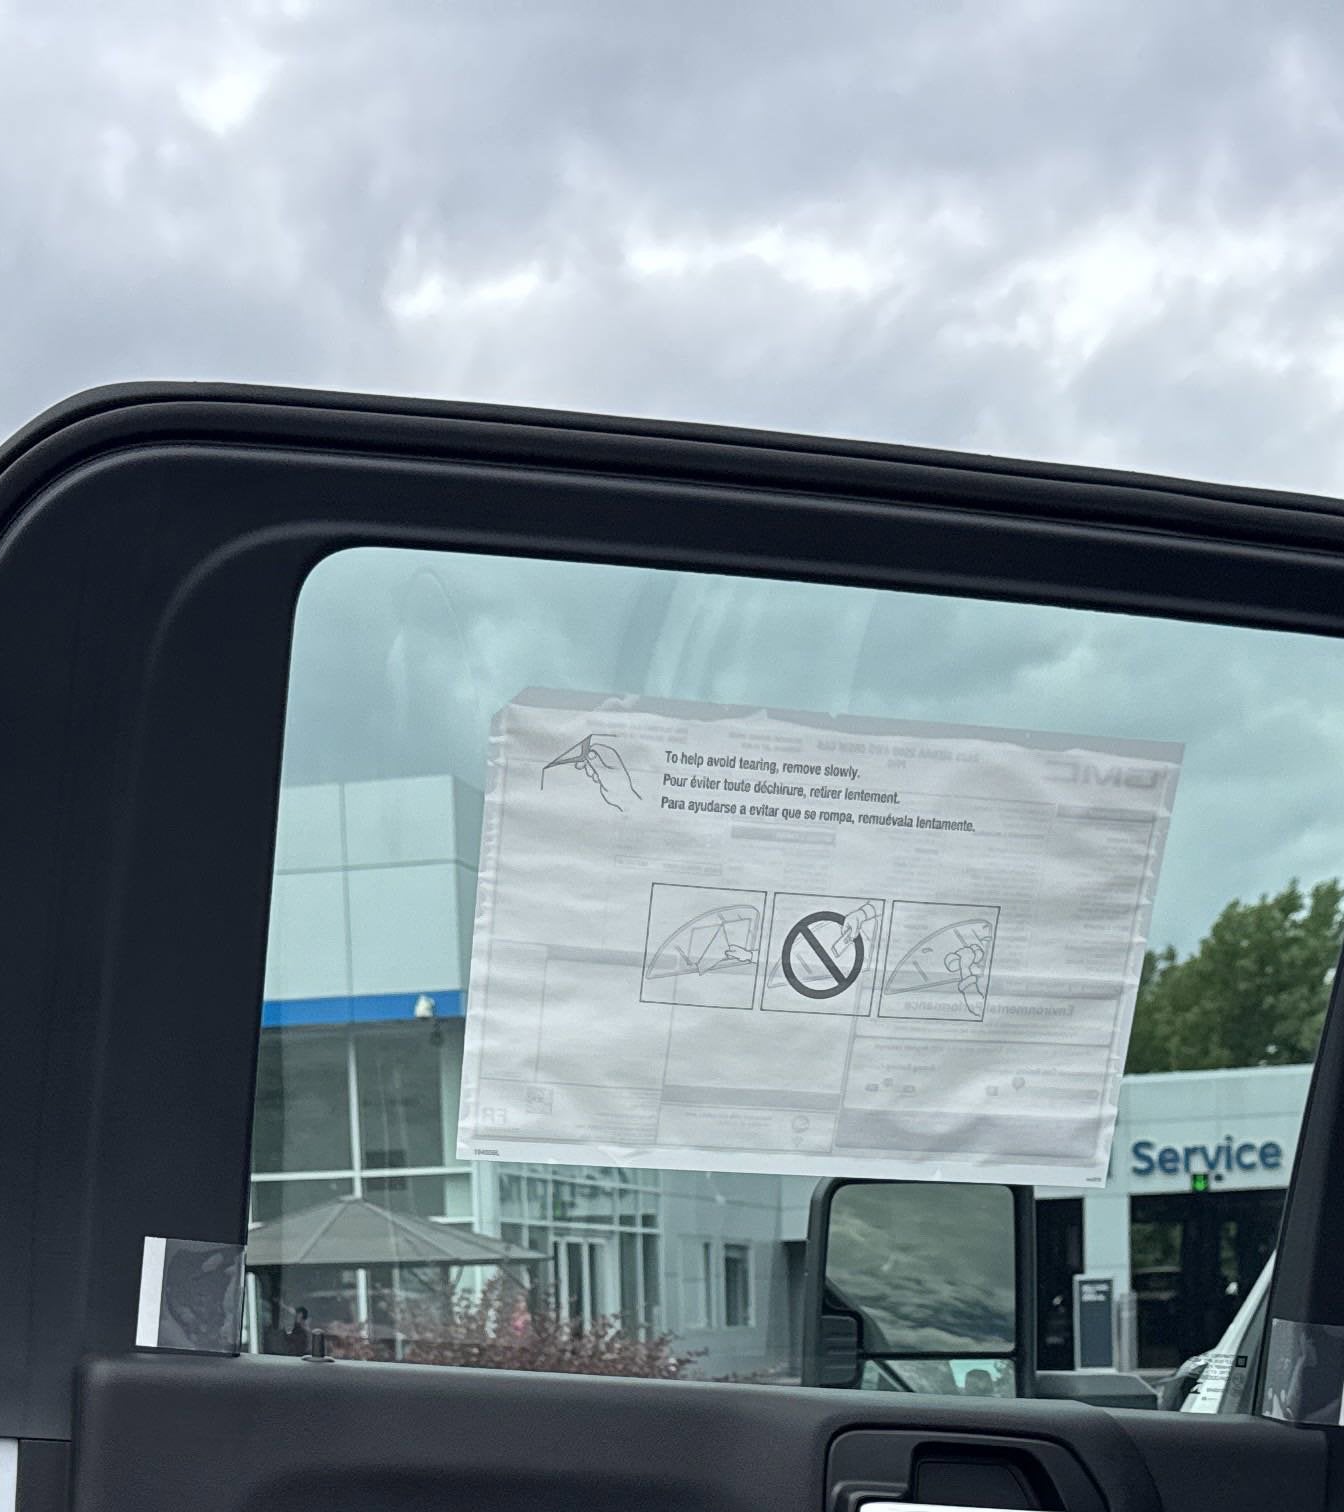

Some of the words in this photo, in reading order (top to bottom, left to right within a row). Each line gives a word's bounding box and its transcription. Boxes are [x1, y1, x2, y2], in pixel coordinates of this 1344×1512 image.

[665, 750, 678, 764] To
[681, 752, 704, 768] help
[706, 755, 736, 769] avoid
[739, 757, 779, 774] tearing,
[782, 761, 821, 775] remove
[824, 764, 860, 780] slowly.
[662, 773, 688, 787] Pour
[690, 775, 721, 790] éviter
[723, 778, 751, 793] toute
[753, 780, 807, 799] déchirure,
[809, 786, 842, 800] retirer
[844, 788, 900, 804] lentement.
[660, 796, 685, 810] Para
[687, 799, 737, 814] ayudarse
[739, 804, 747, 815] a
[749, 803, 779, 818] evitar
[781, 807, 802, 821] que
[804, 808, 817, 820] se
[819, 811, 855, 825] rompa,
[858, 813, 913, 828] remuévala
[916, 815, 976, 832] lentamente.
[1132, 1134, 1282, 1175] Service
